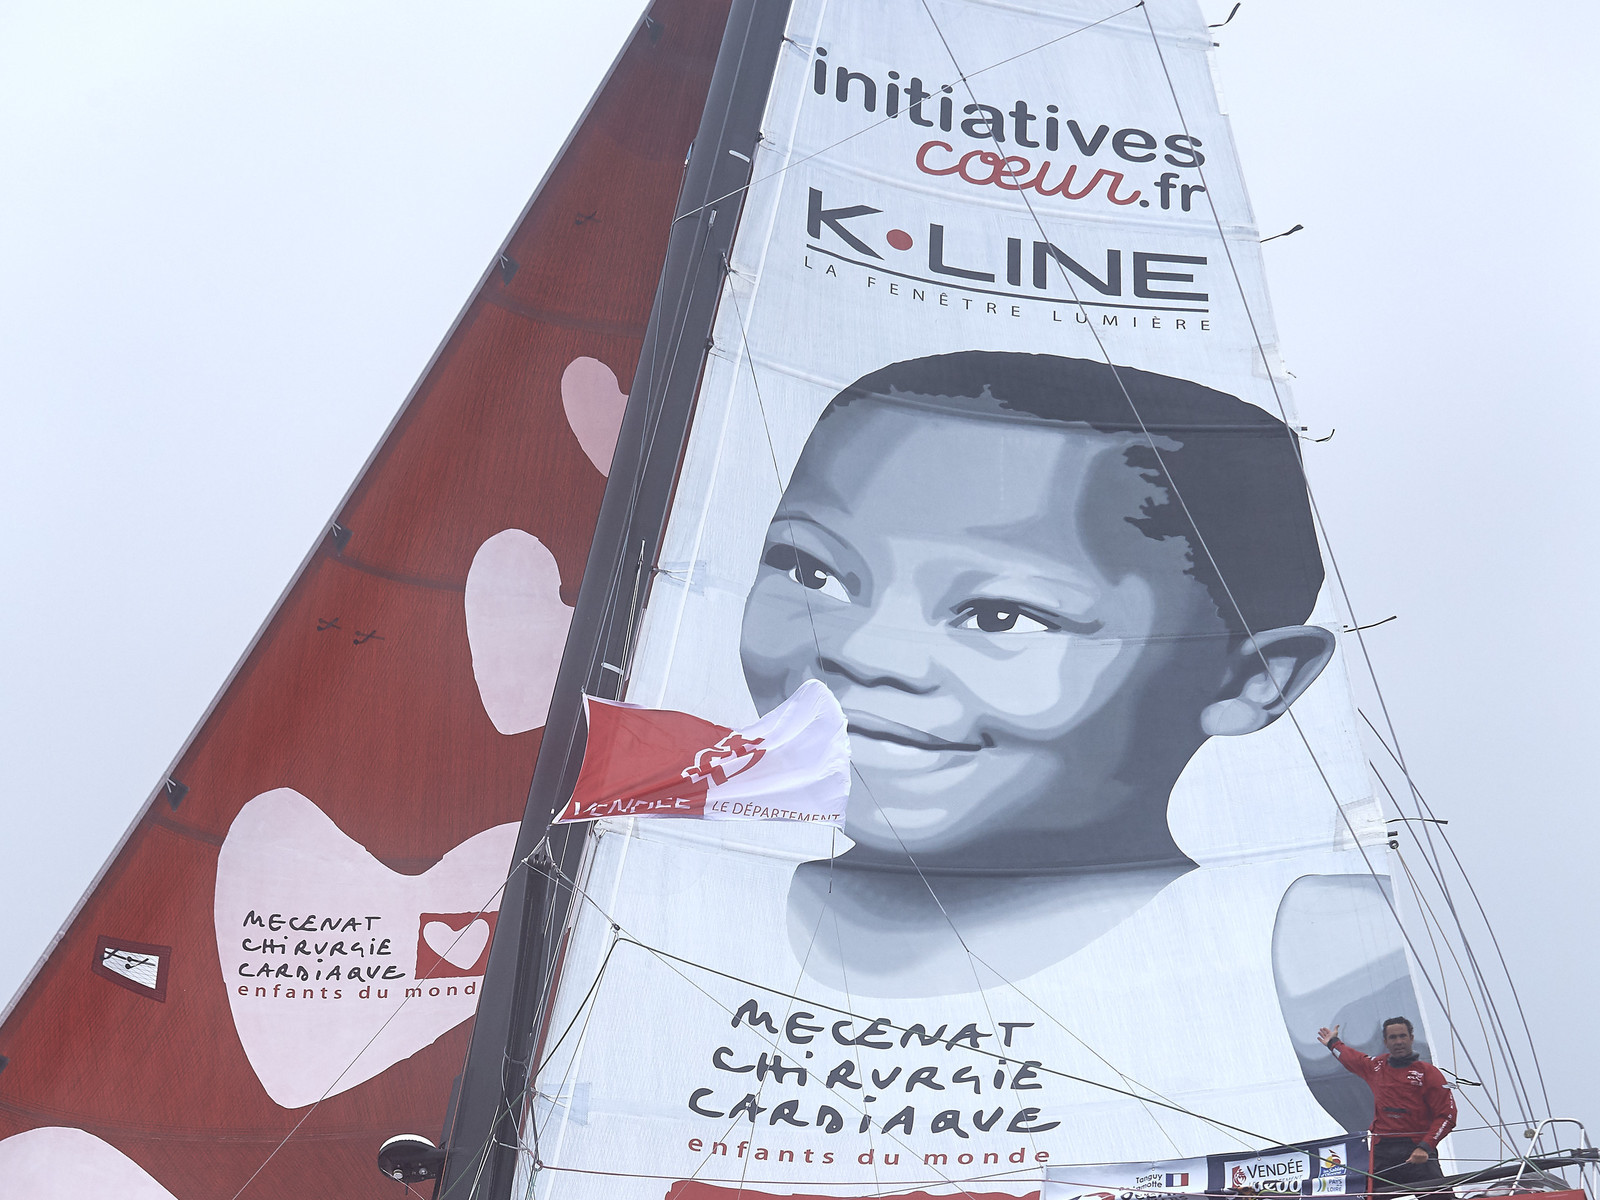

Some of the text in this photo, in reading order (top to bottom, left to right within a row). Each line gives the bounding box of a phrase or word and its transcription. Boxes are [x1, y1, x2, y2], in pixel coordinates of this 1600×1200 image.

[813, 46, 1206, 168] initiatives
[804, 255, 1211, 331] LA FENÊTRE LUMIÈRE
[712, 800, 730, 813] LE
[242, 910, 381, 932] MECENAT
[237, 981, 477, 1000] enfants du mond
[731, 999, 1035, 1051] MECENAT
[687, 1136, 1051, 1166] enfants du monde
[1246, 1158, 1304, 1179] VENDÉE
